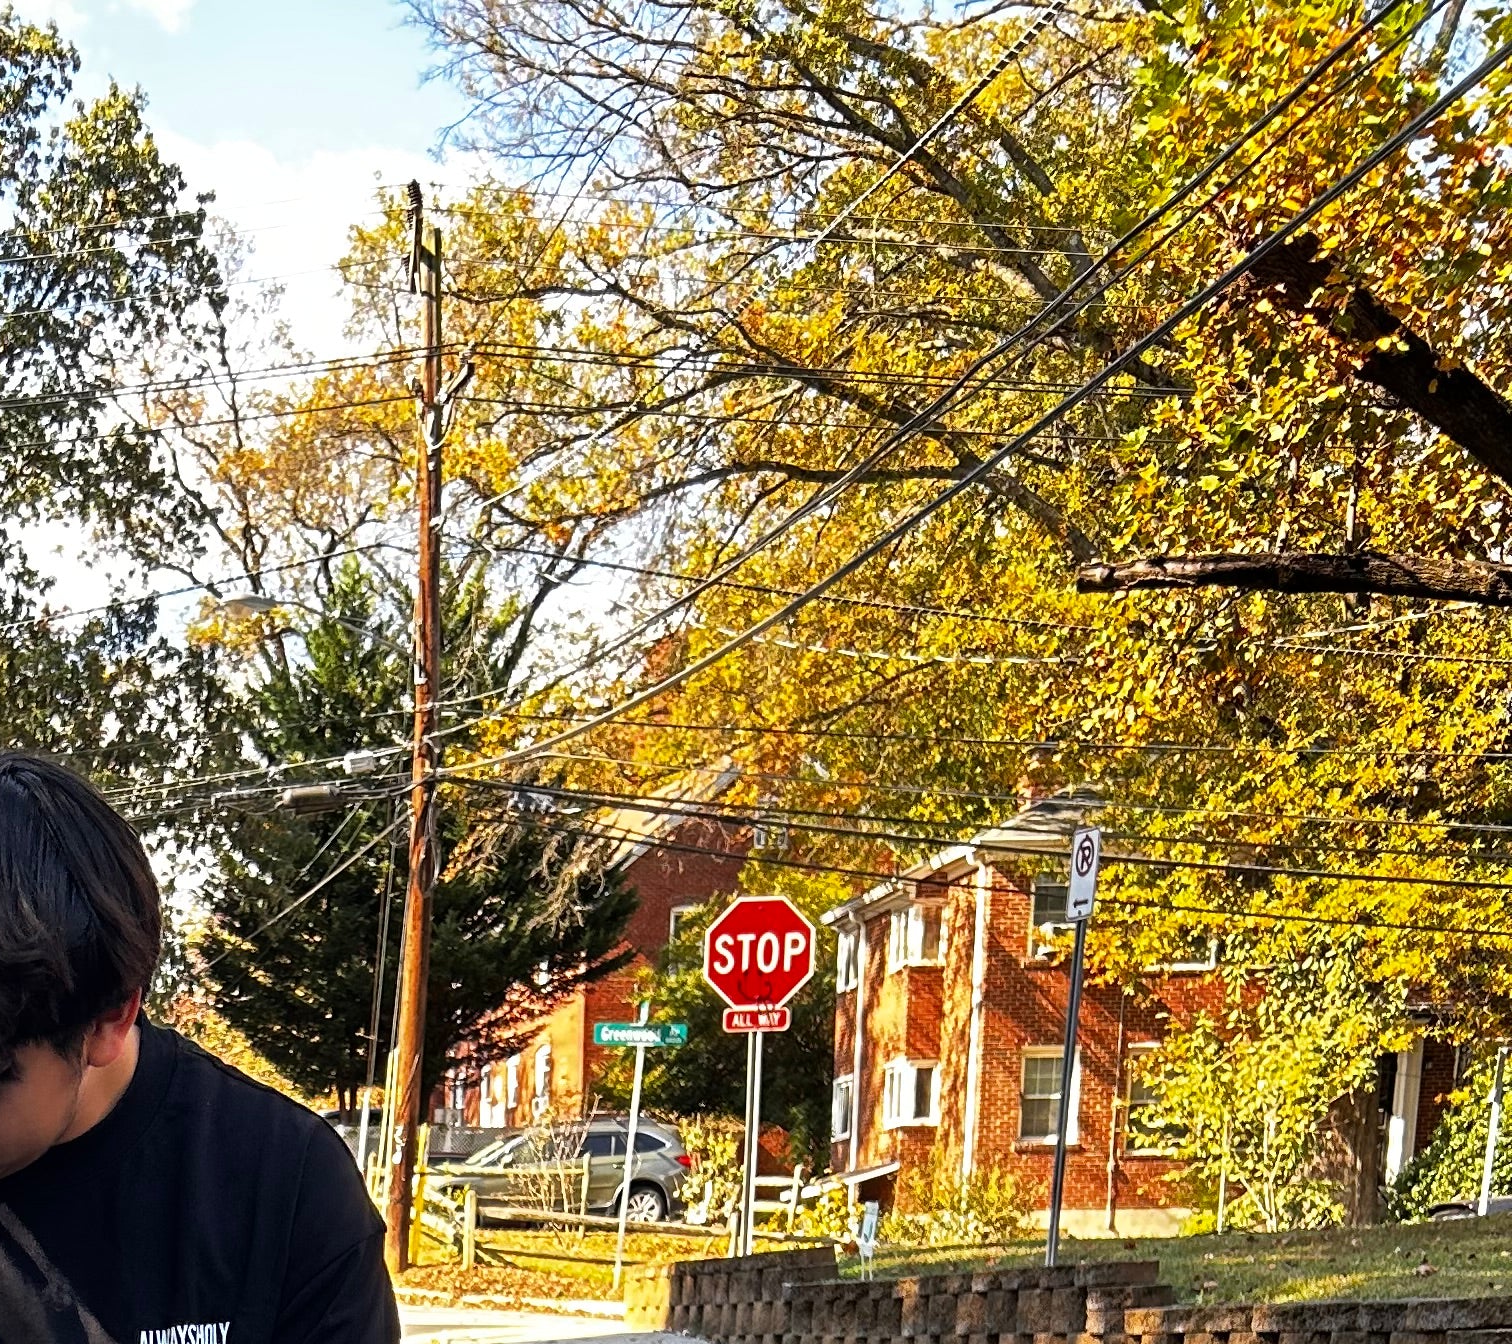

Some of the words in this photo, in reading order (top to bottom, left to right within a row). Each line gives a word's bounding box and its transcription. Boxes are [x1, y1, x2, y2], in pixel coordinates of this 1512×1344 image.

[713, 931, 807, 975] STOP
[731, 1012, 753, 1028] ALL
[757, 1011, 782, 1027] WAY
